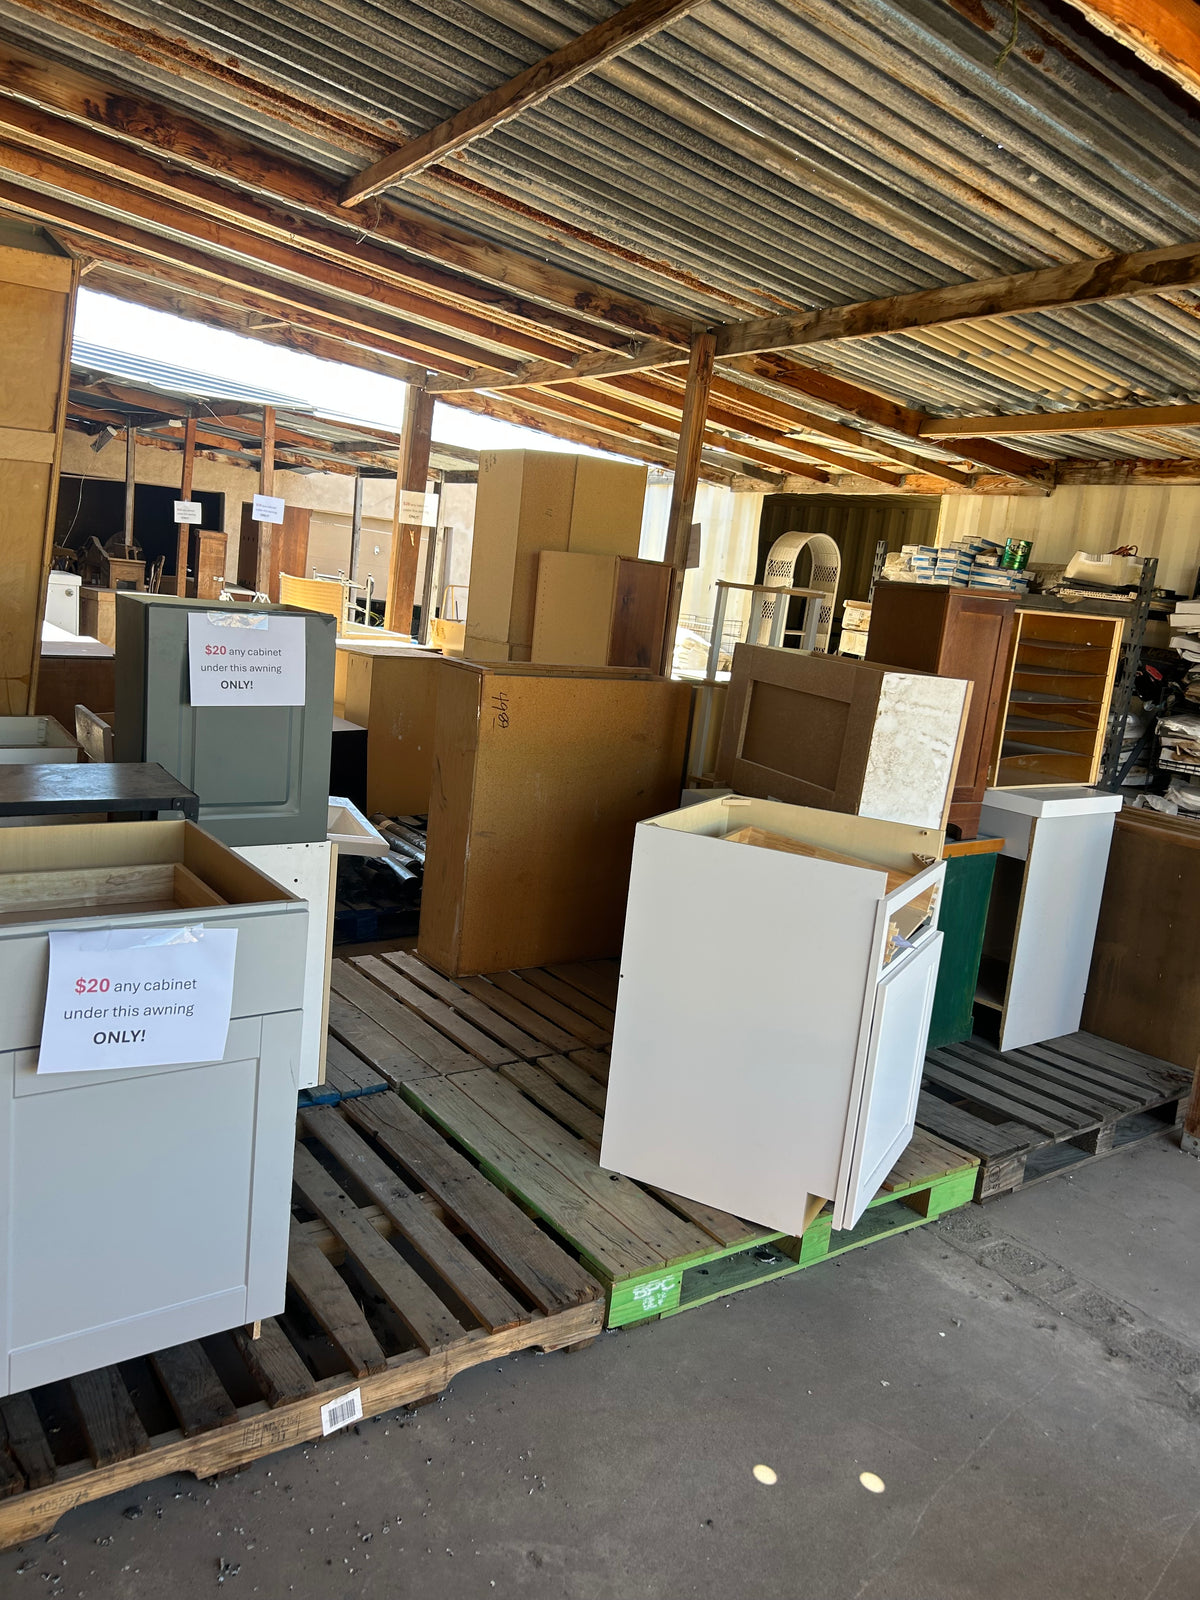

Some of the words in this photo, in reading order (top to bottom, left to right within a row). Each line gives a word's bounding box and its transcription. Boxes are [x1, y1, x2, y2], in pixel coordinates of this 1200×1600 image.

[205, 644, 227, 656] $20
[229, 648, 245, 657] any
[247, 648, 282, 657] cabinet
[200, 664, 228, 672] under
[230, 664, 247, 672] this
[249, 664, 282, 674] awning
[220, 680, 253, 689] ONLY!
[74, 977, 110, 995] $20
[114, 981, 140, 995] any
[144, 978, 197, 992] cabinet
[63, 1006, 109, 1020] under
[112, 1004, 139, 1018] this
[143, 1003, 195, 1017] awning
[93, 1029, 146, 1045] ONLY!
